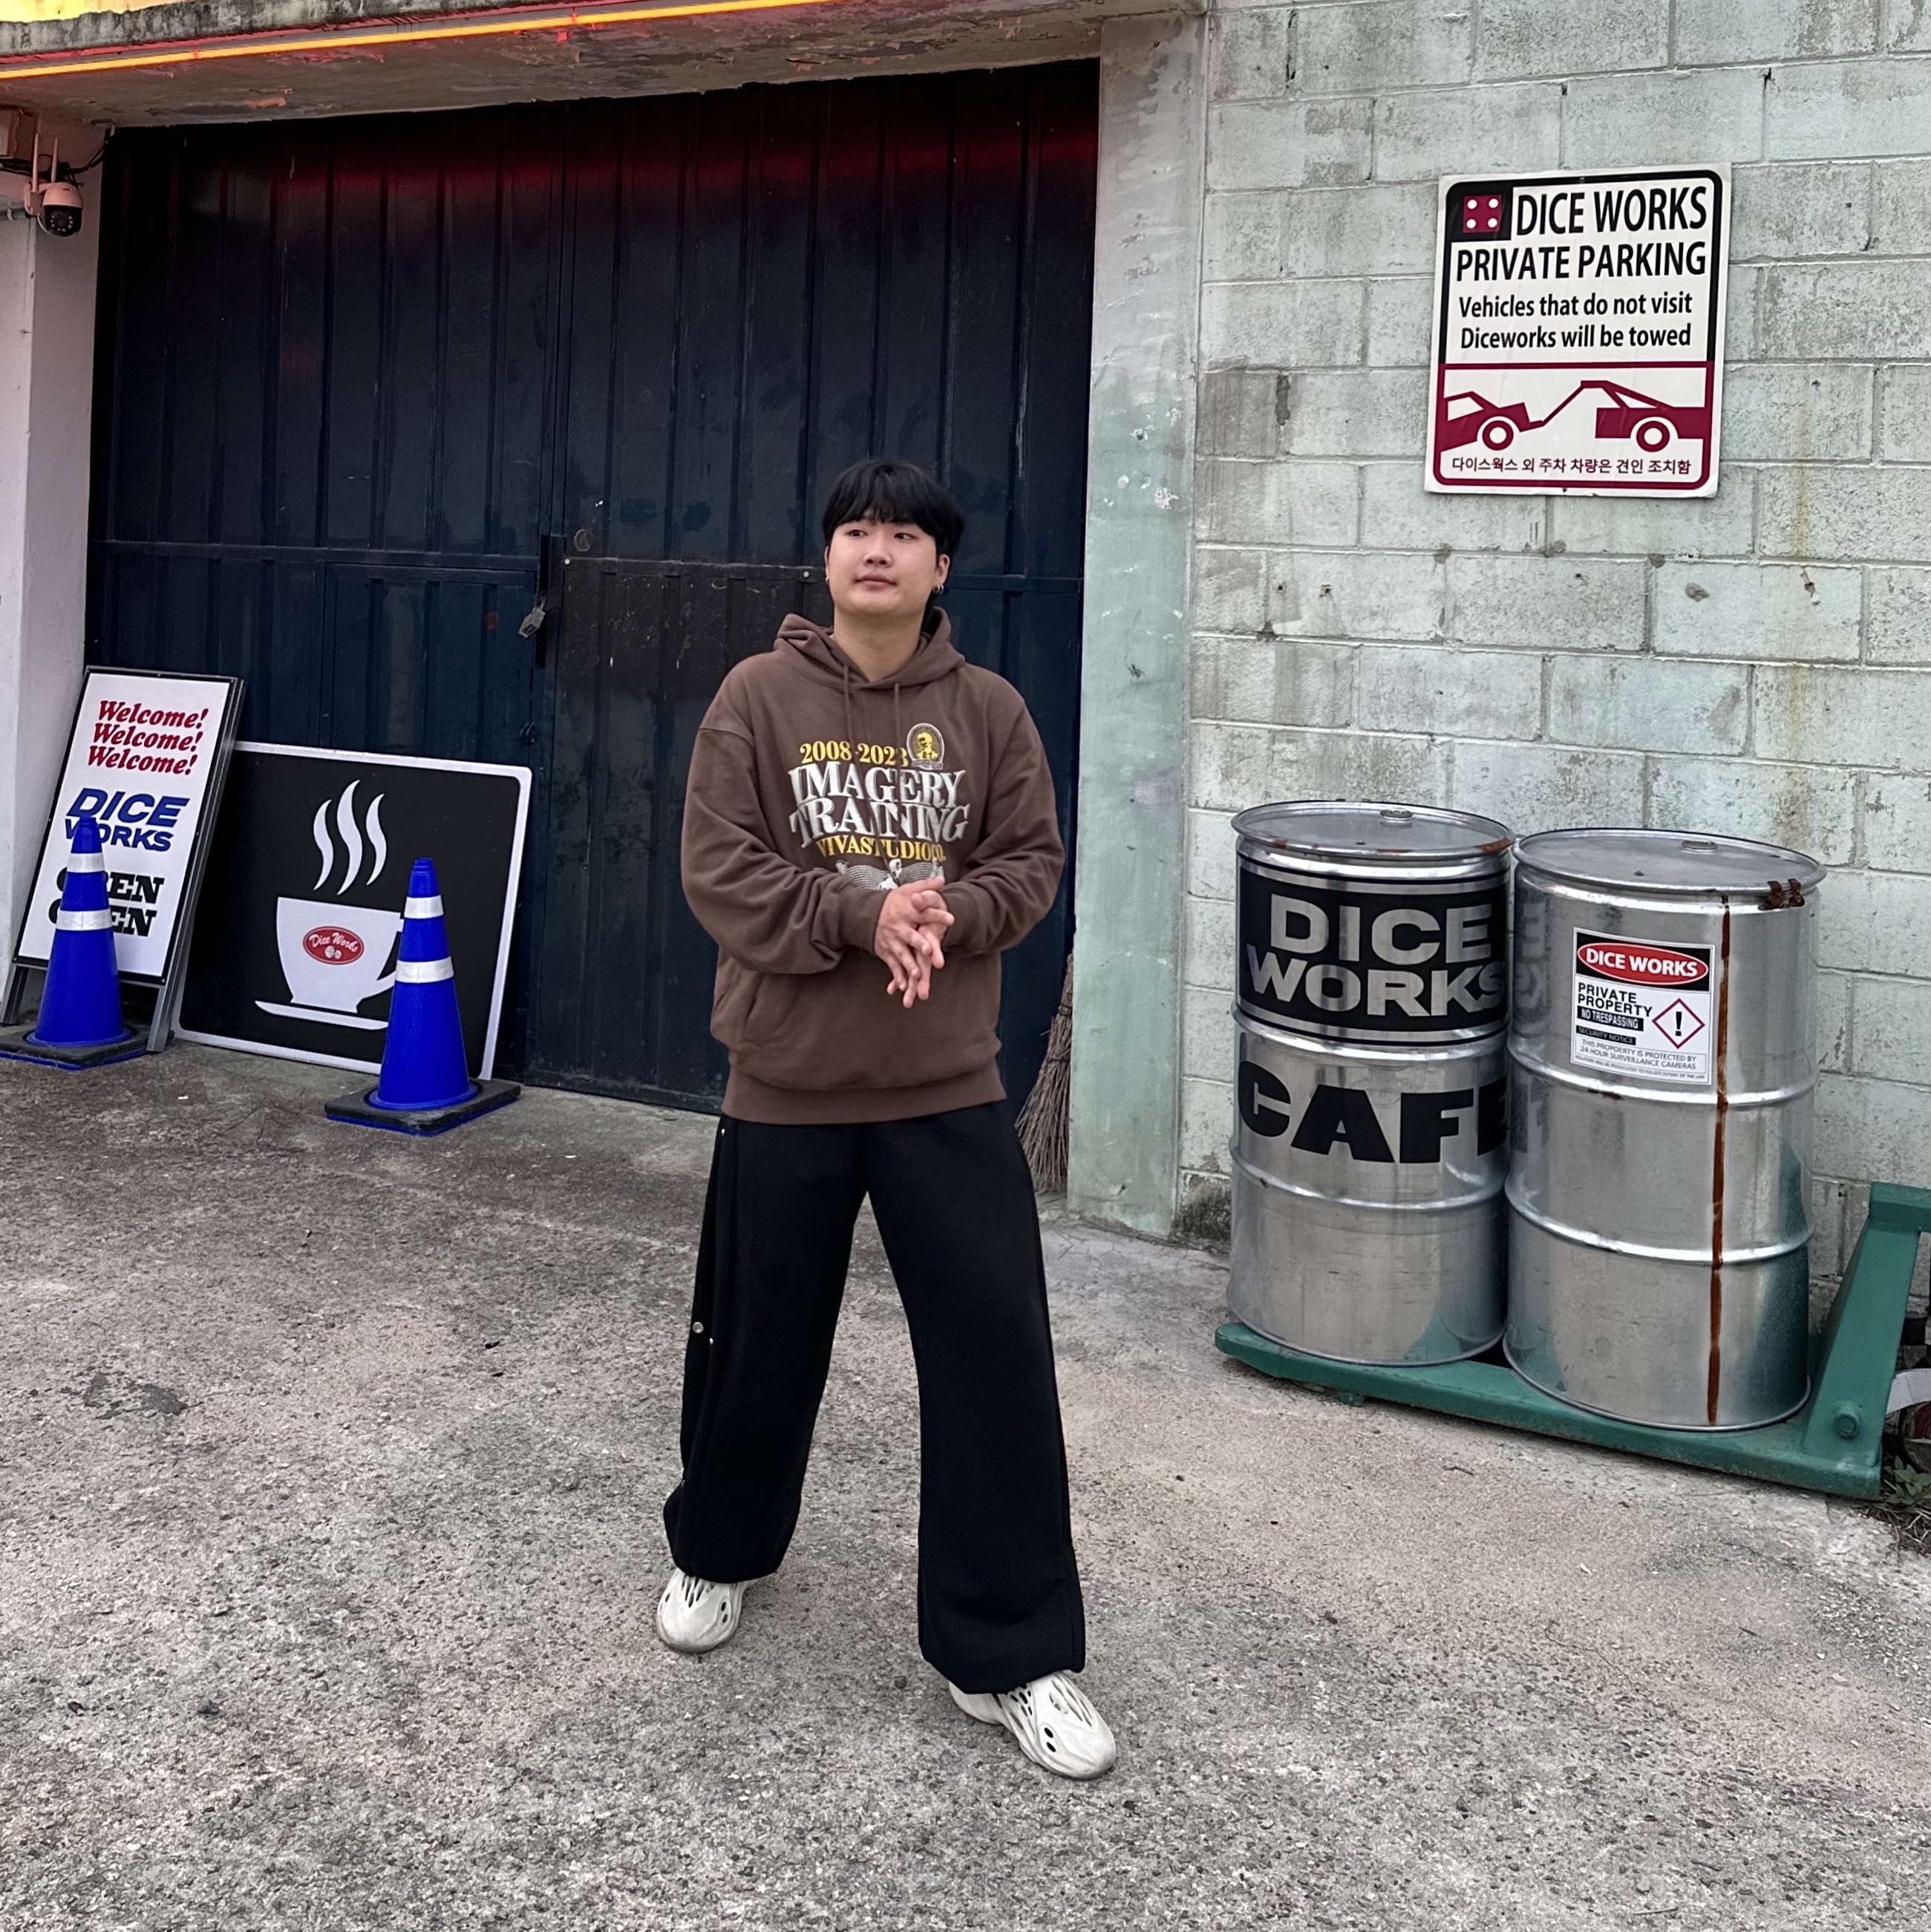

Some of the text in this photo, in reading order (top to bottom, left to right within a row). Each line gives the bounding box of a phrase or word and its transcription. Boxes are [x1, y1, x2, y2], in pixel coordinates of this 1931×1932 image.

[1517, 186, 1708, 236] DICE WORKS
[1456, 241, 1707, 281] PRIVATE PARKING
[1459, 291, 1693, 318] Vehicles that do not visit
[1461, 323, 1692, 349] Diceworks will be towed
[1451, 457, 1691, 475] 다이스웍스 외 주차 차량은 견인 조치함
[99, 699, 209, 729] Welcome!
[94, 722, 203, 752] Welcome!
[88, 745, 198, 776] Welcome!
[788, 761, 967, 809] IMAGERY
[65, 788, 191, 828] DICE
[788, 797, 970, 848] TRAINING
[56, 867, 165, 904] EN
[48, 898, 157, 937] EN
[1270, 892, 1492, 965] DICE
[309, 932, 358, 952] Dice Works
[1586, 947, 1698, 977] DICE WORKS
[1247, 943, 1506, 1017] WORKS
[1578, 982, 1637, 1003] PRIVATE
[1578, 993, 1653, 1017] PROPERTY
[1581, 1008, 1638, 1029] NO TRESPASSING
[1582, 1038, 1595, 1047] THIS
[1644, 1051, 1686, 1062] PROTECTED
[1589, 1048, 1609, 1057] HOUR
[1610, 1052, 1659, 1067] SURVEILLANCE
[1661, 1060, 1696, 1070] CAMERAS
